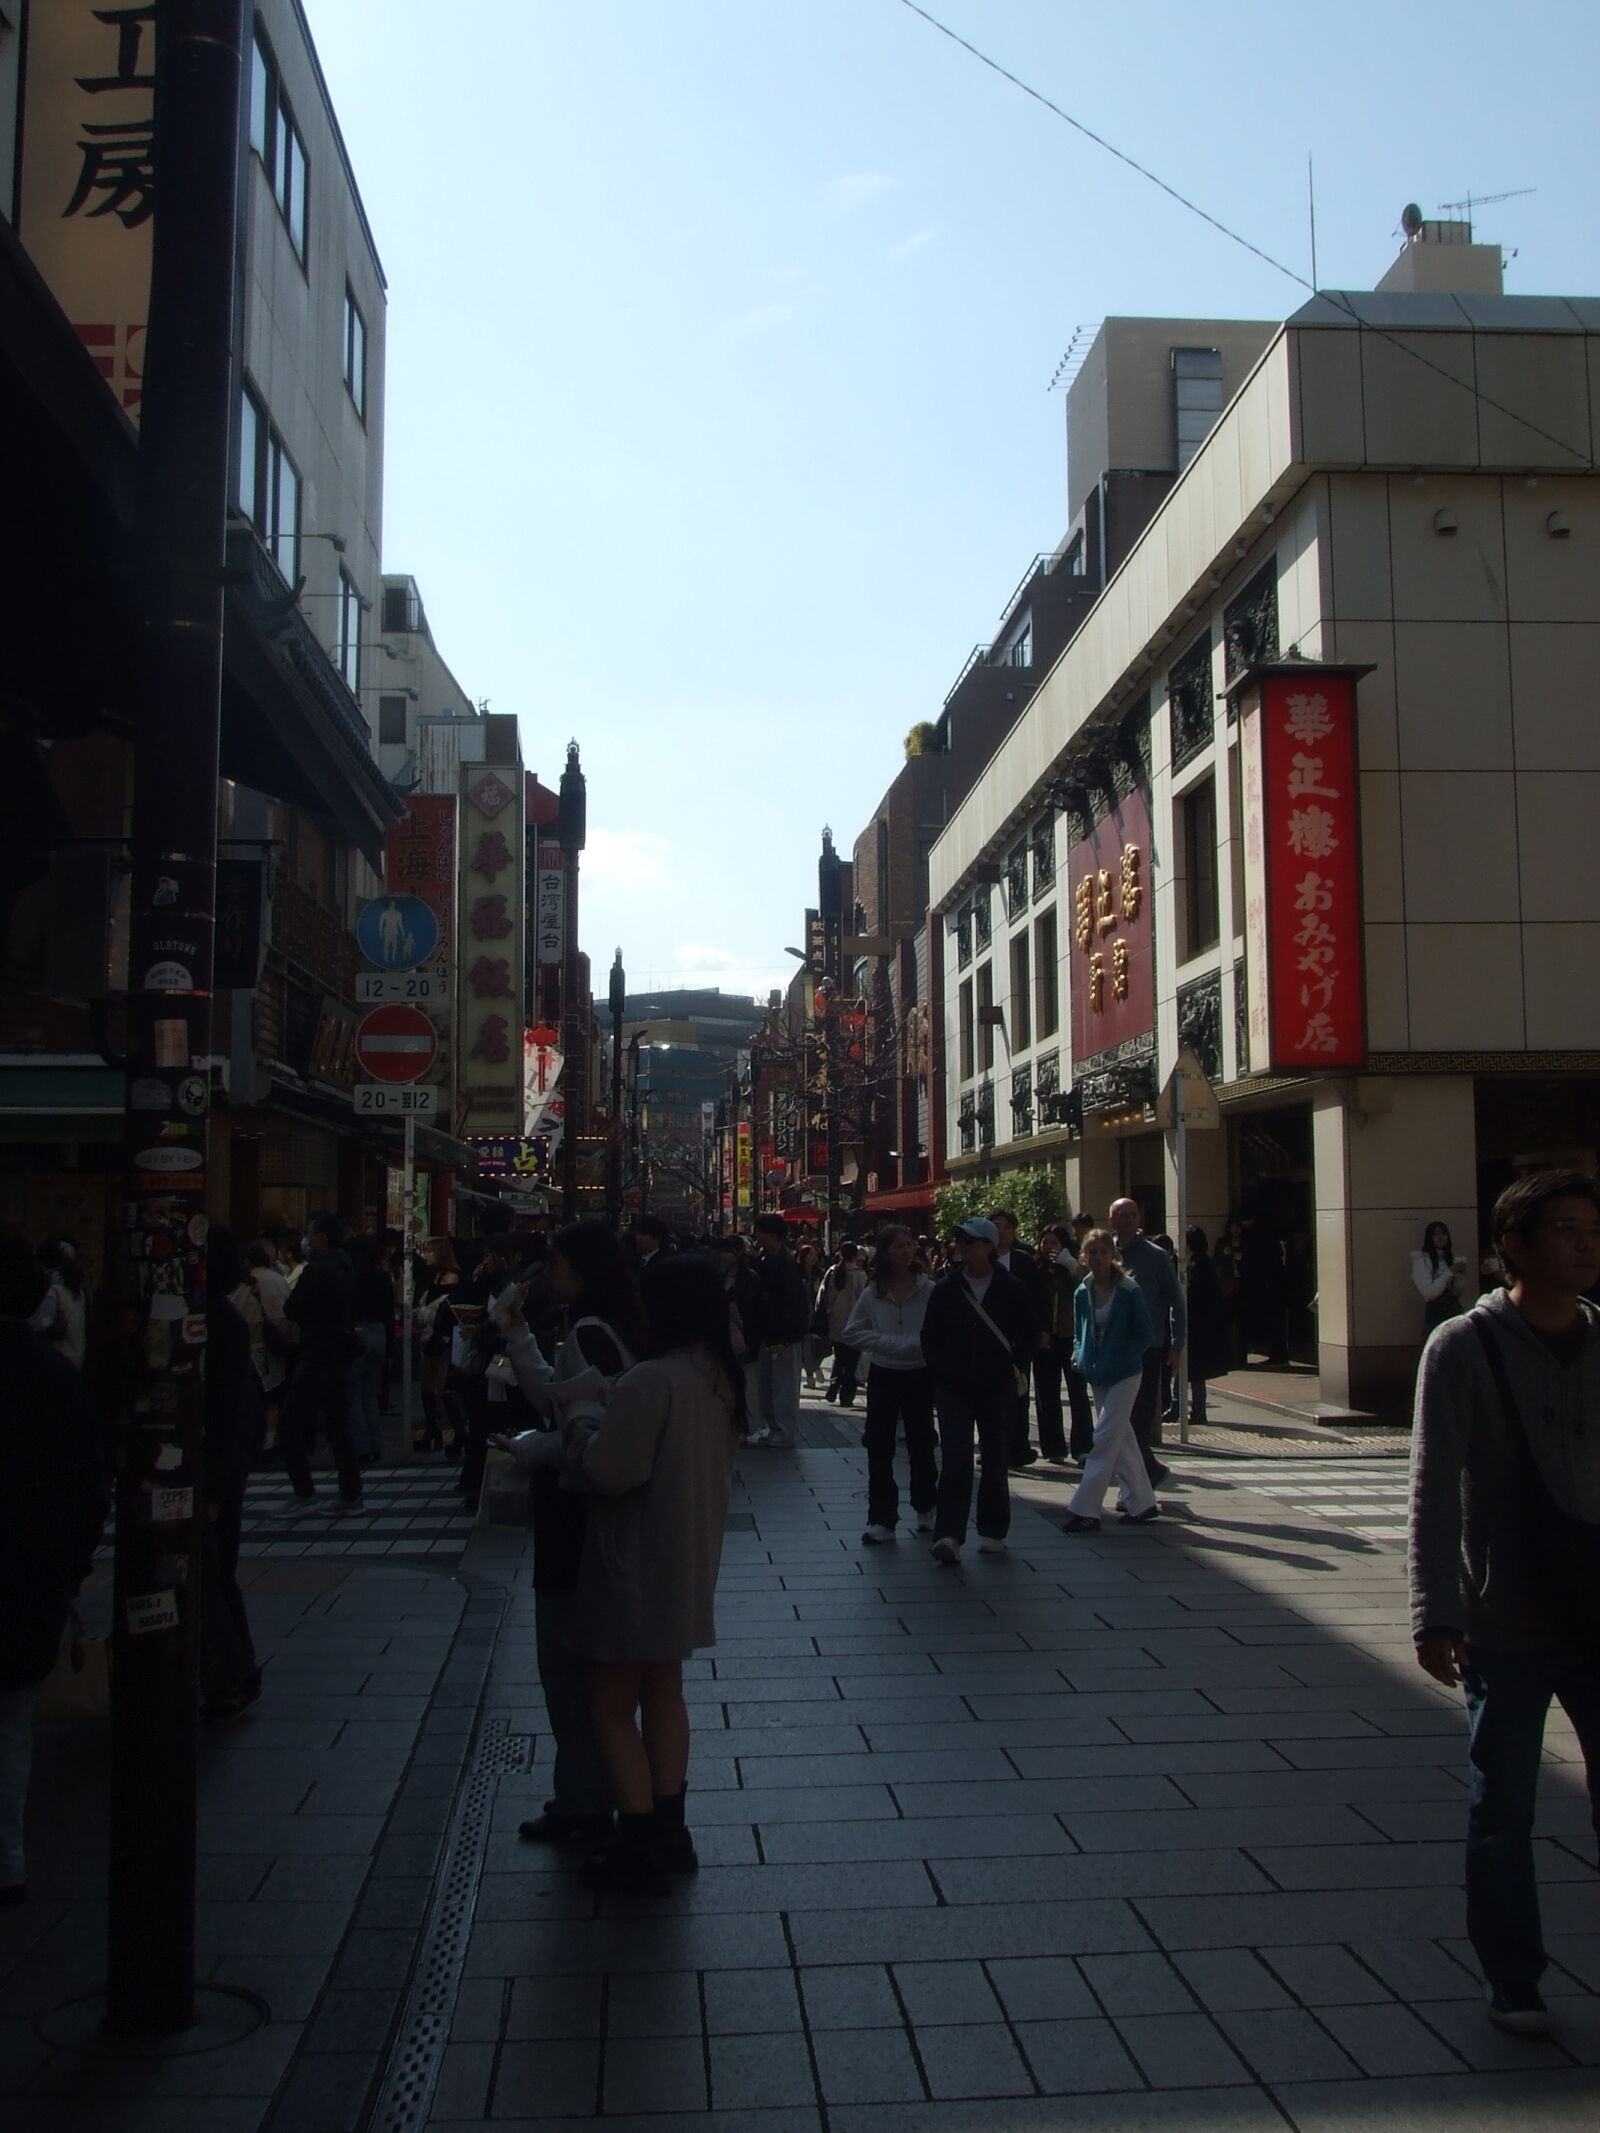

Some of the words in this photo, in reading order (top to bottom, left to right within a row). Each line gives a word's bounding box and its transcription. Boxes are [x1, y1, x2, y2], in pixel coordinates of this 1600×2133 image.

[397, 810, 435, 895] 上海
[1284, 692, 1341, 1055] 華正樓おみやげ店
[540, 873, 561, 949] 台湾屋台
